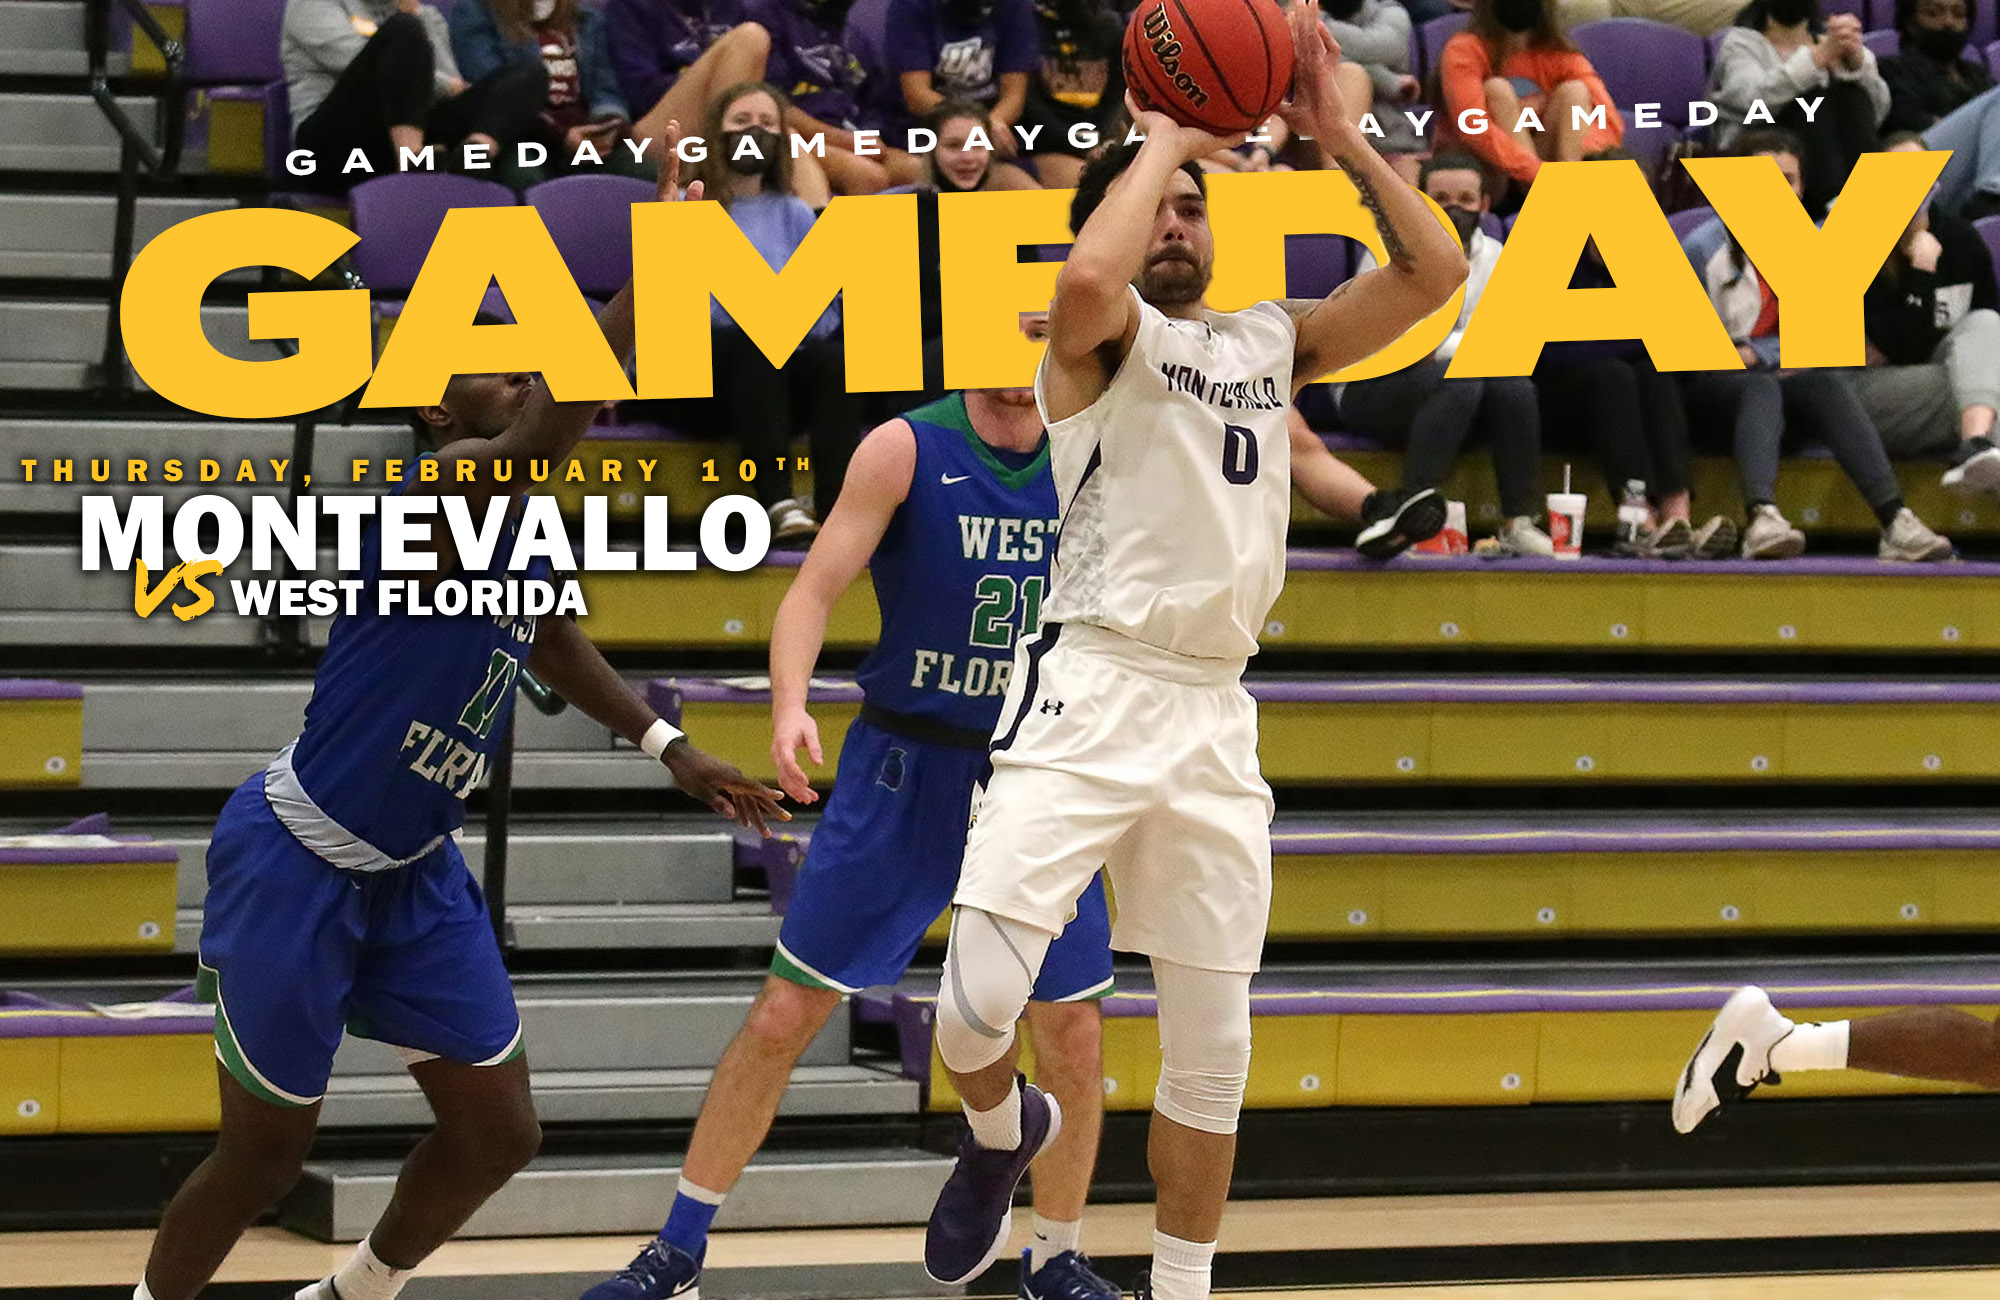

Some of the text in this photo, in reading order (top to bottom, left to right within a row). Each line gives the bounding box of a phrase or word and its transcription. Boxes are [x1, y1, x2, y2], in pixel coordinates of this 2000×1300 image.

[1143, 2, 1209, 109] Wilson
[969, 574, 1046, 649] 21
[911, 649, 1014, 696] FLOR
